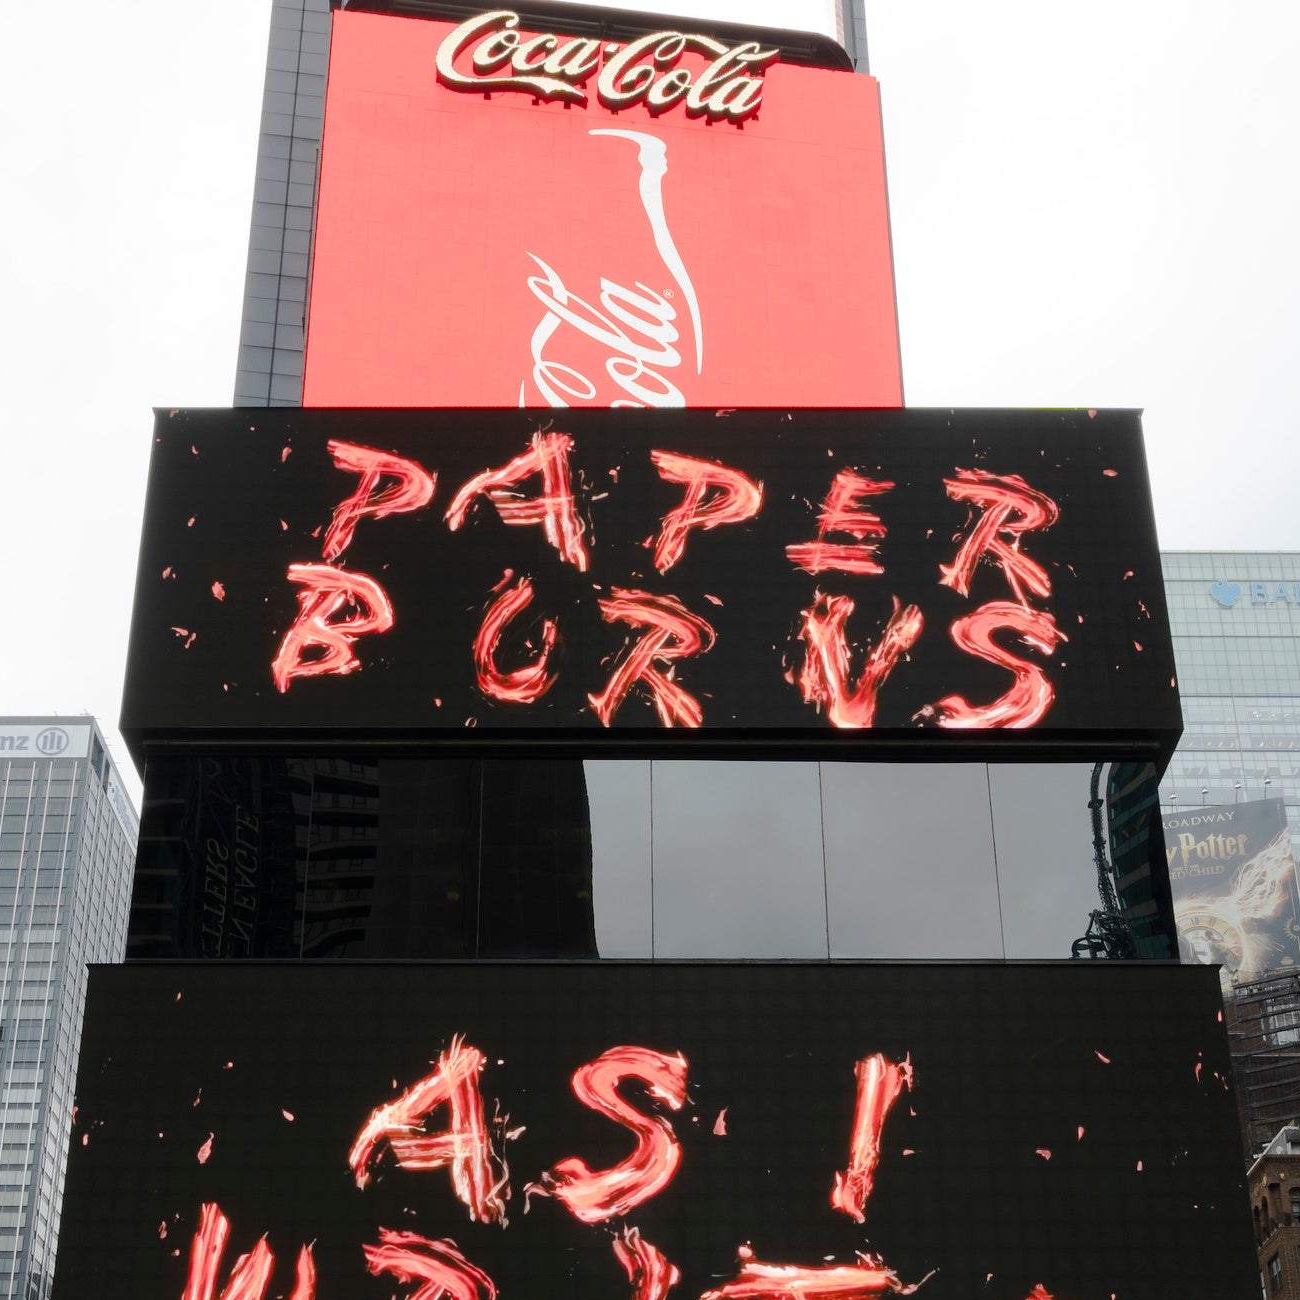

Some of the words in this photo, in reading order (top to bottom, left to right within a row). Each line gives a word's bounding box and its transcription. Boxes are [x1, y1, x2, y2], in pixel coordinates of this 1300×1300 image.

[436, 10, 780, 120] Coca-Cola
[324, 430, 1062, 600] PAPER
[1177, 831, 1249, 866] Potter
[348, 1033, 690, 1226] AS
[831, 1051, 905, 1223] I
